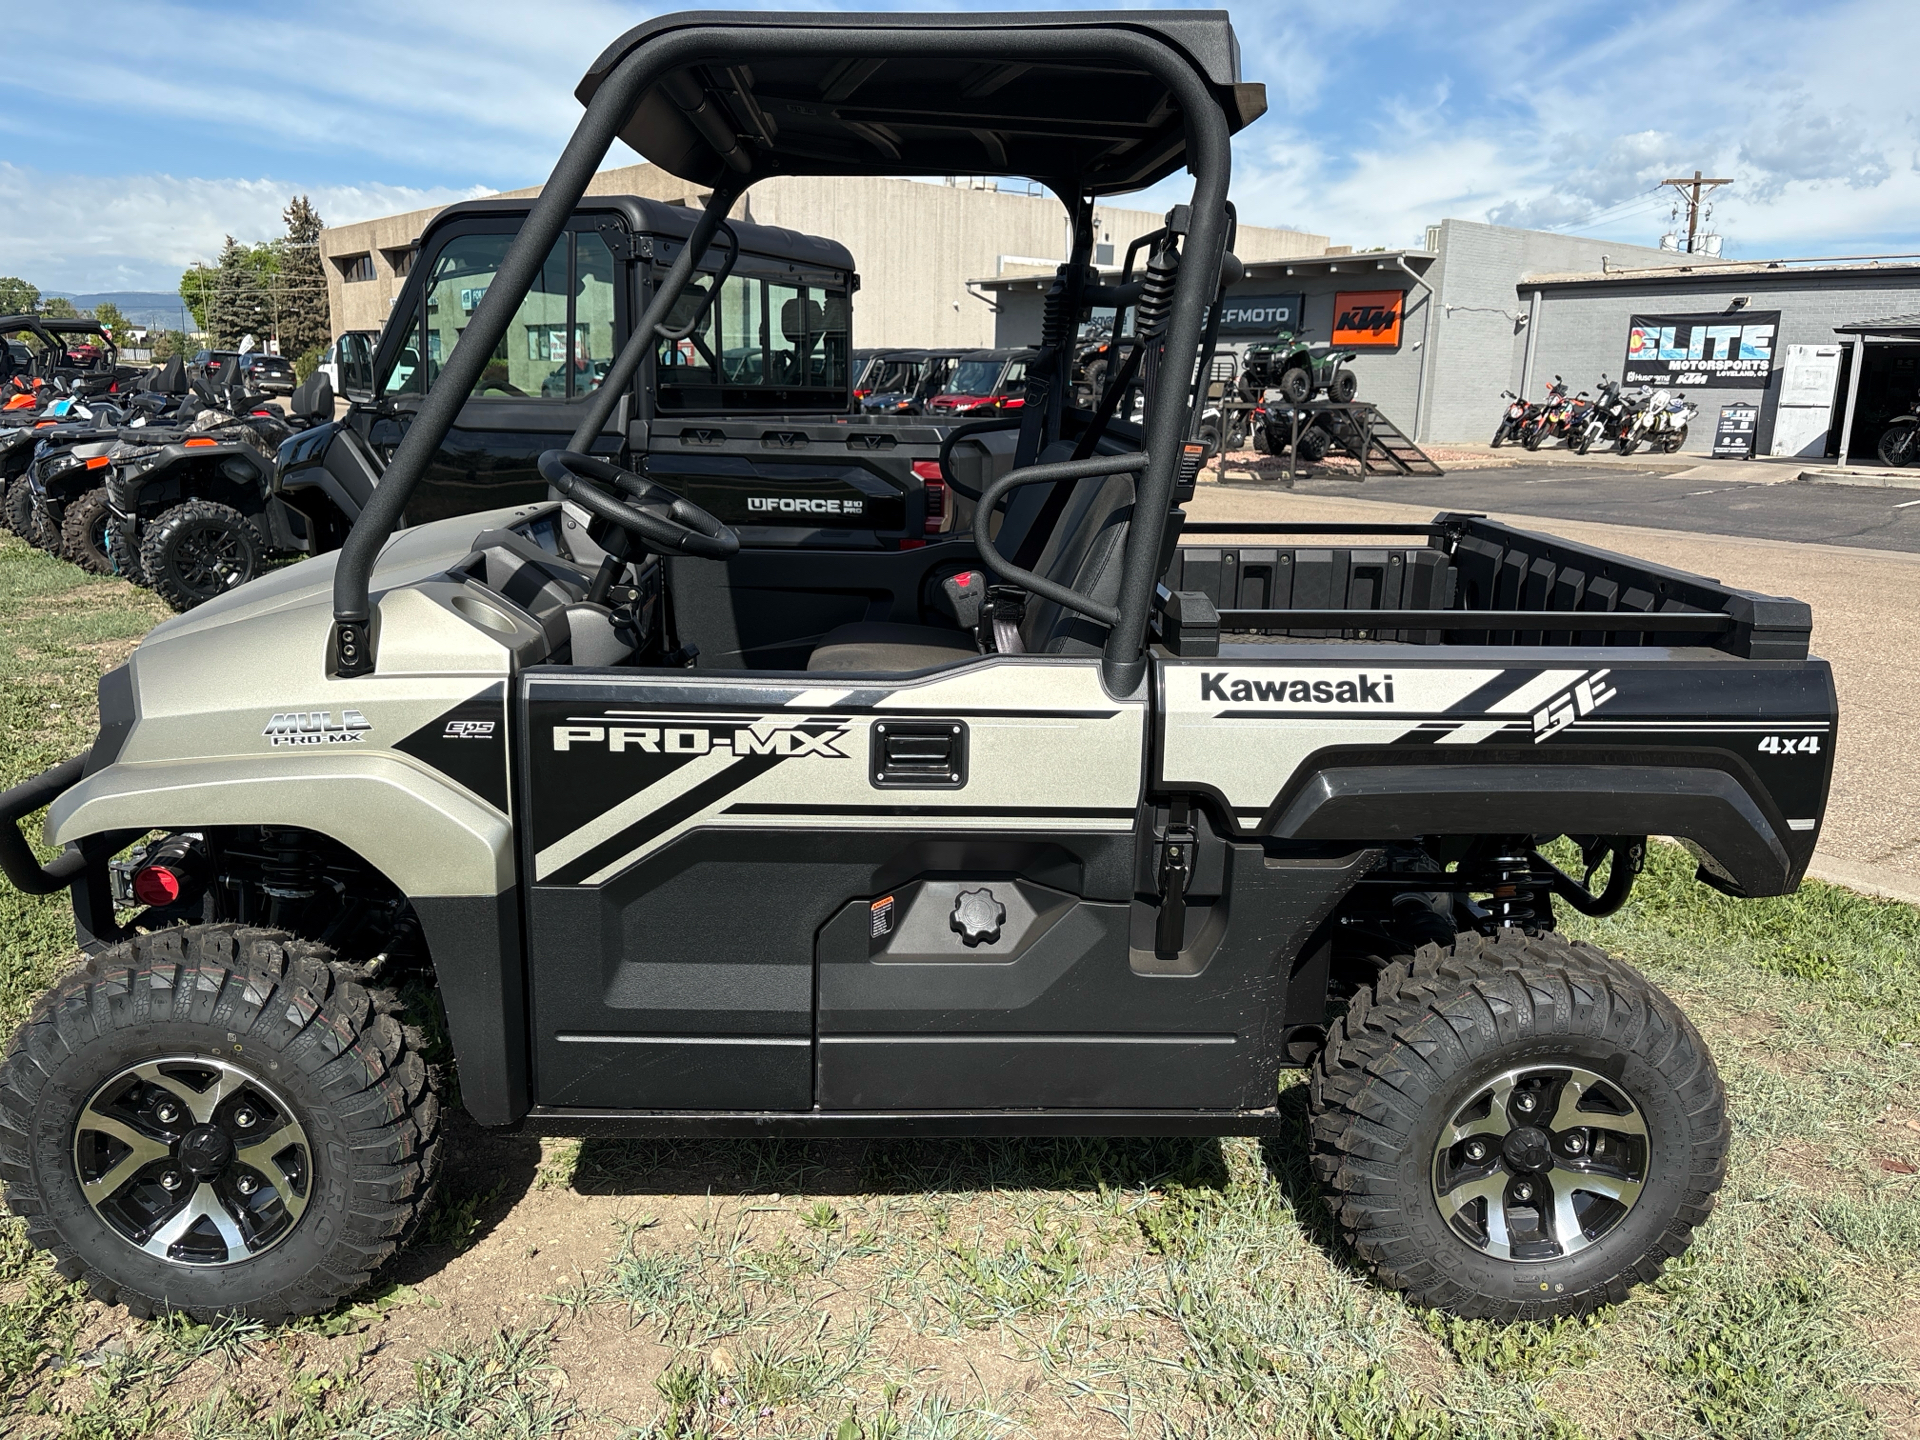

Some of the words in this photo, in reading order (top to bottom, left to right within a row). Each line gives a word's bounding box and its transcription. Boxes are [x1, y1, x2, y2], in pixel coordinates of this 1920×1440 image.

[1219, 307, 1290, 323] CFMOTO
[1335, 305, 1396, 330] KTM
[1628, 324, 1776, 361] ELITE
[1668, 360, 1770, 371] MOTORSPORTS
[1675, 372, 1709, 385] KTM
[747, 497, 841, 513] UFORCE
[1200, 672, 1395, 703] Kawasaki
[1533, 668, 1617, 744] SE
[262, 709, 374, 736] MULE
[271, 732, 367, 746] PRO-MX
[553, 726, 852, 758] PRO-MX
[1757, 736, 1821, 754] 4x4
[307, 1106, 349, 1246] DURO
[1403, 1161, 1462, 1270] DURO
